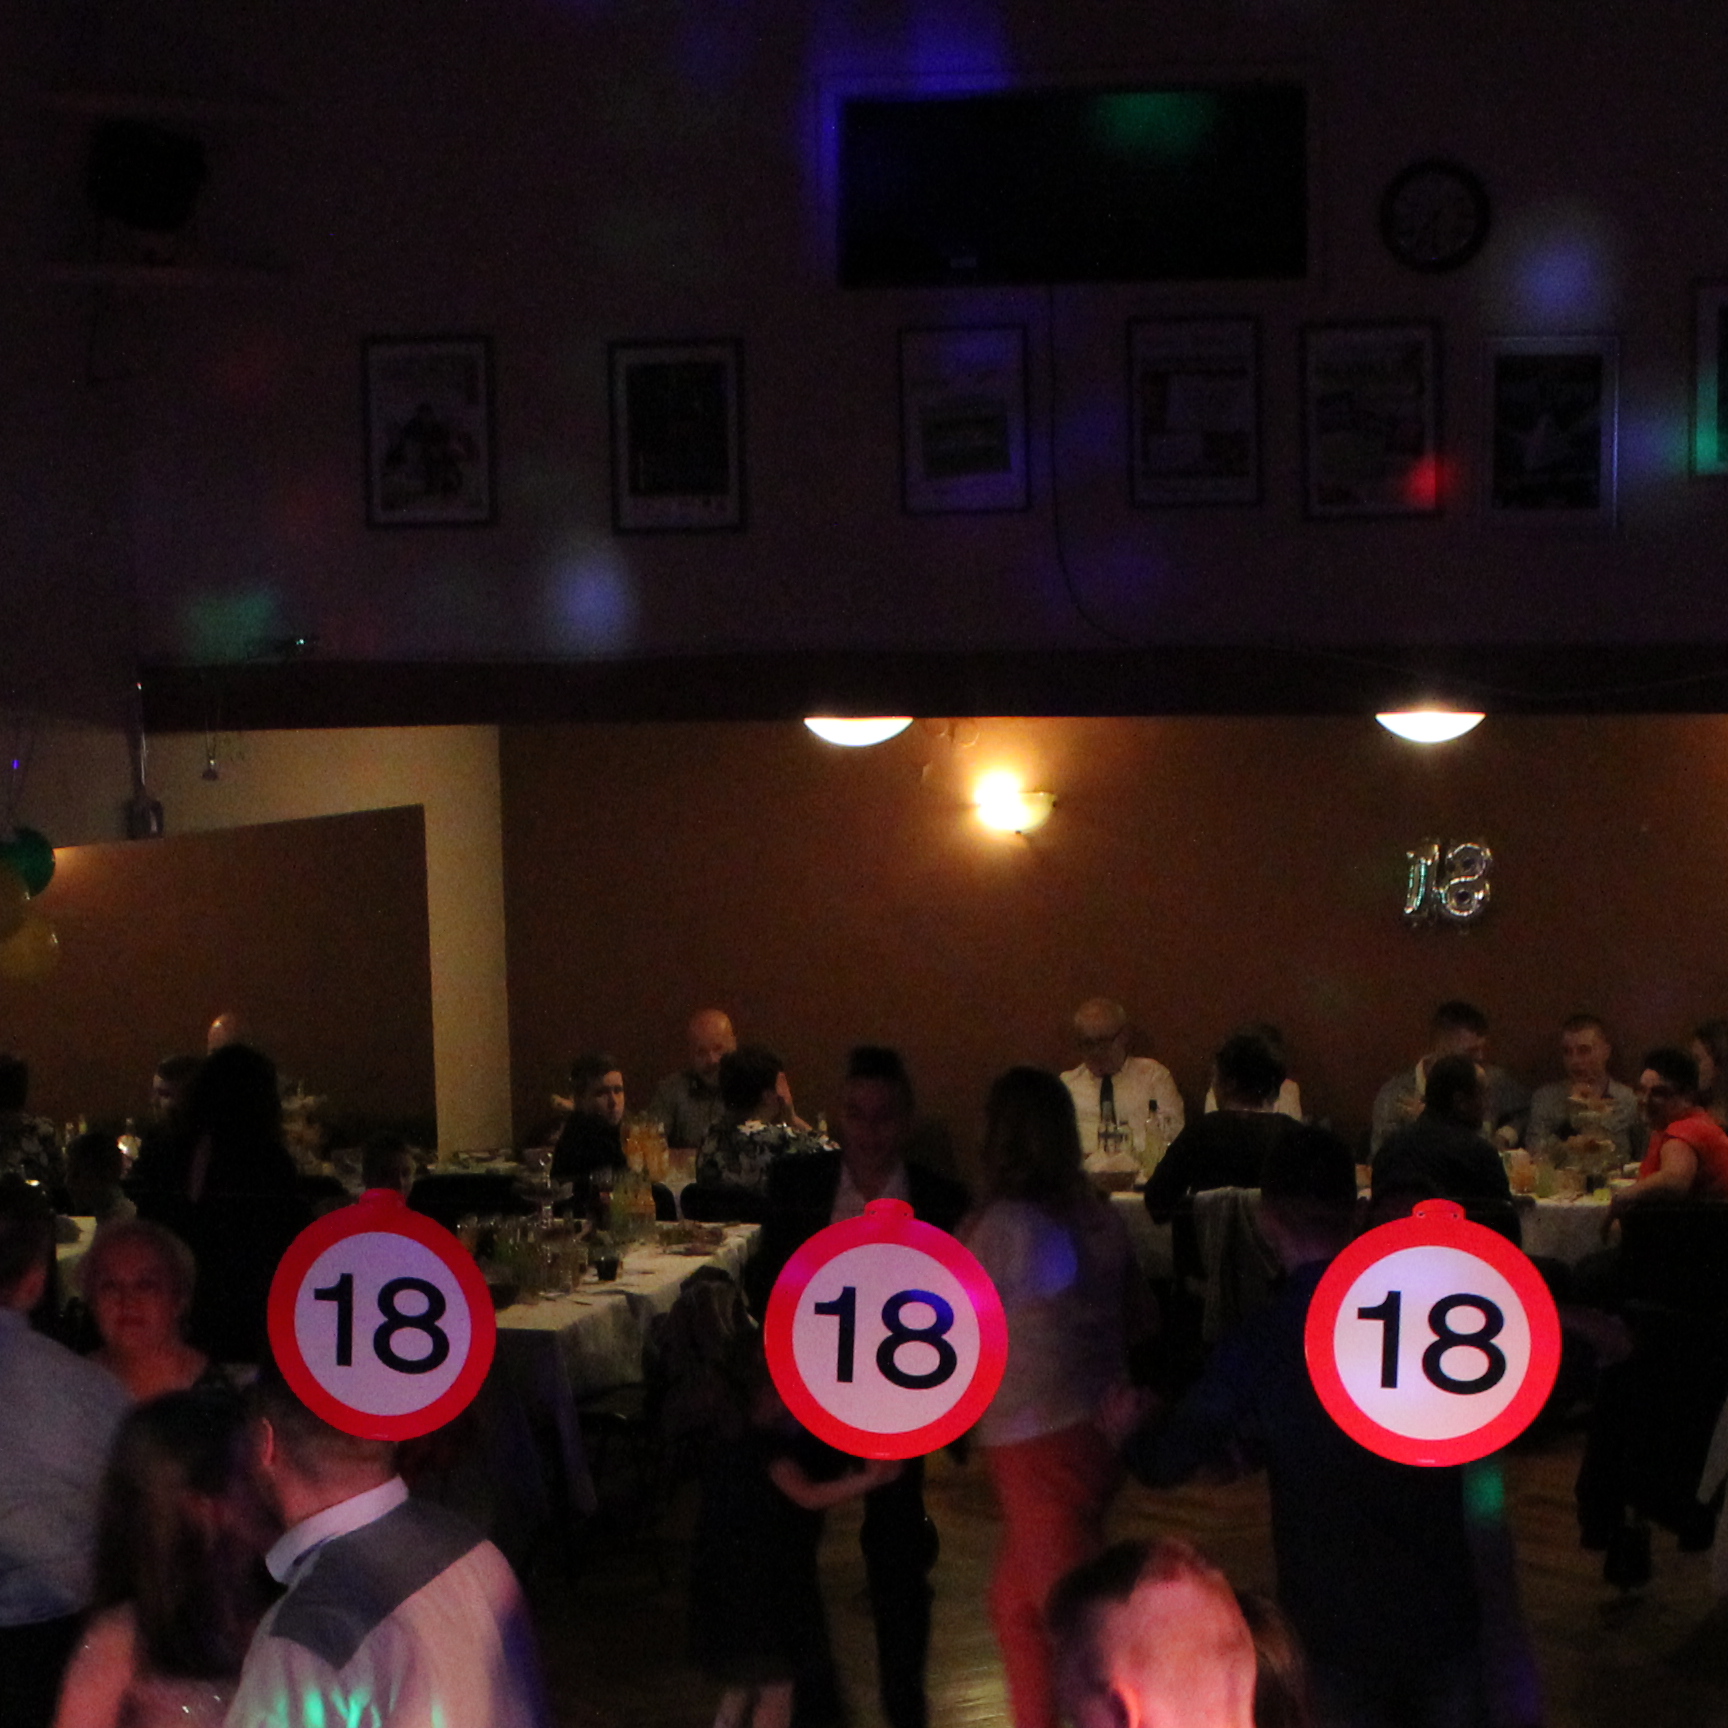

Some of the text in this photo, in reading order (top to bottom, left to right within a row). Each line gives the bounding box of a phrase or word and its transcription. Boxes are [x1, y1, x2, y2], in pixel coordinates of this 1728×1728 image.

[1403, 841, 1492, 919] 18
[314, 1273, 449, 1374] 18
[814, 1286, 957, 1390] 18
[1357, 1291, 1506, 1395] 18
